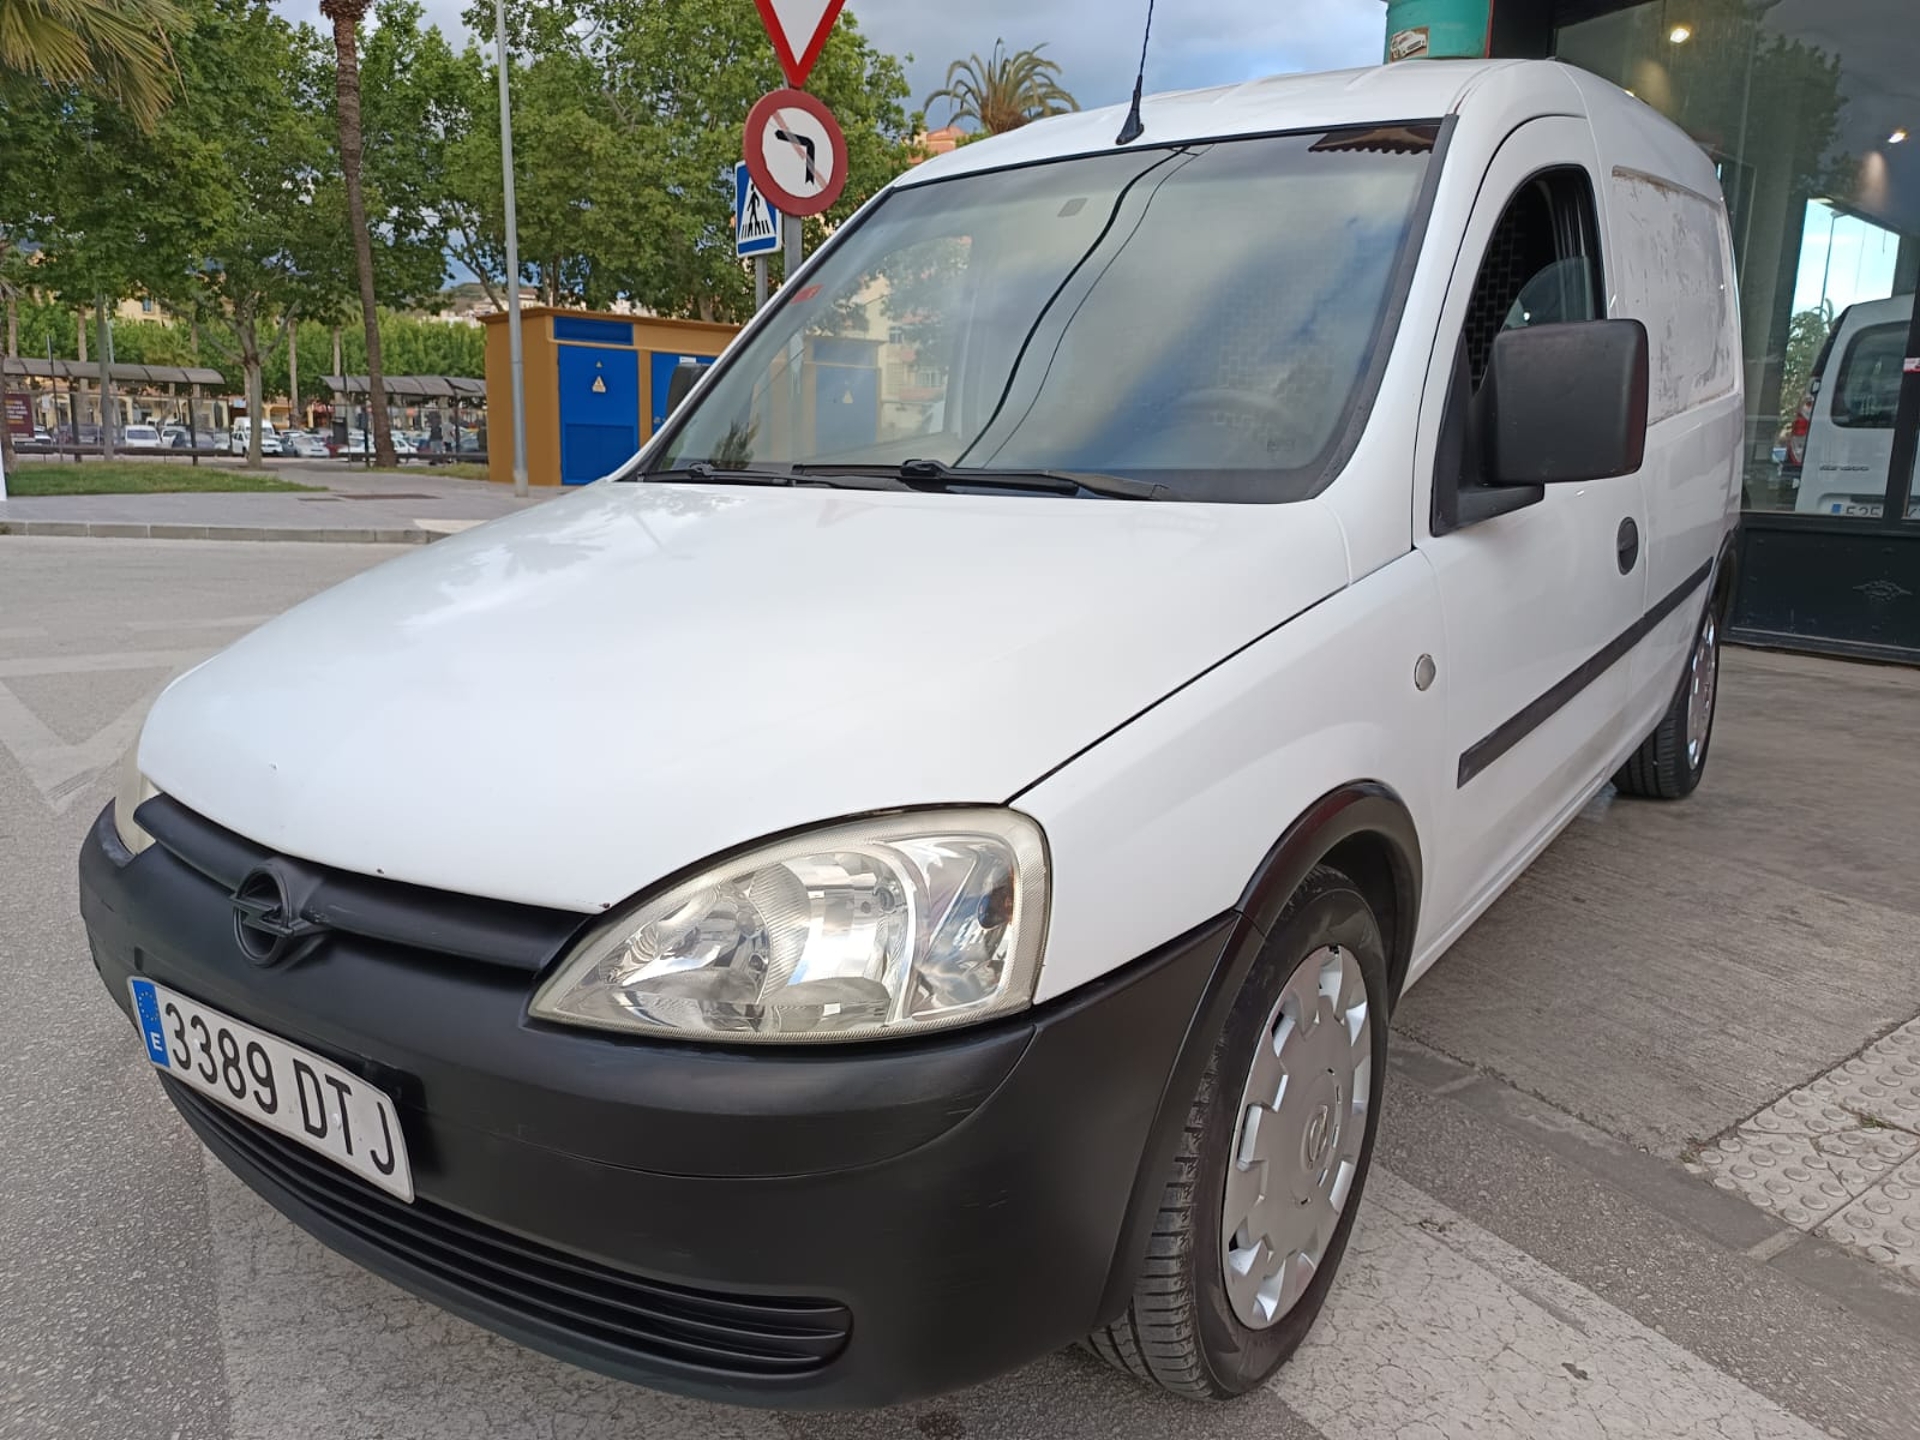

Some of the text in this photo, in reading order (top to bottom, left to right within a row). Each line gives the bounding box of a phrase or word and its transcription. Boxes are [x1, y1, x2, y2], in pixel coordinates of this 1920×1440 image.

[150, 1031, 163, 1051] E
[165, 1002, 396, 1176] 3389 DTJ
